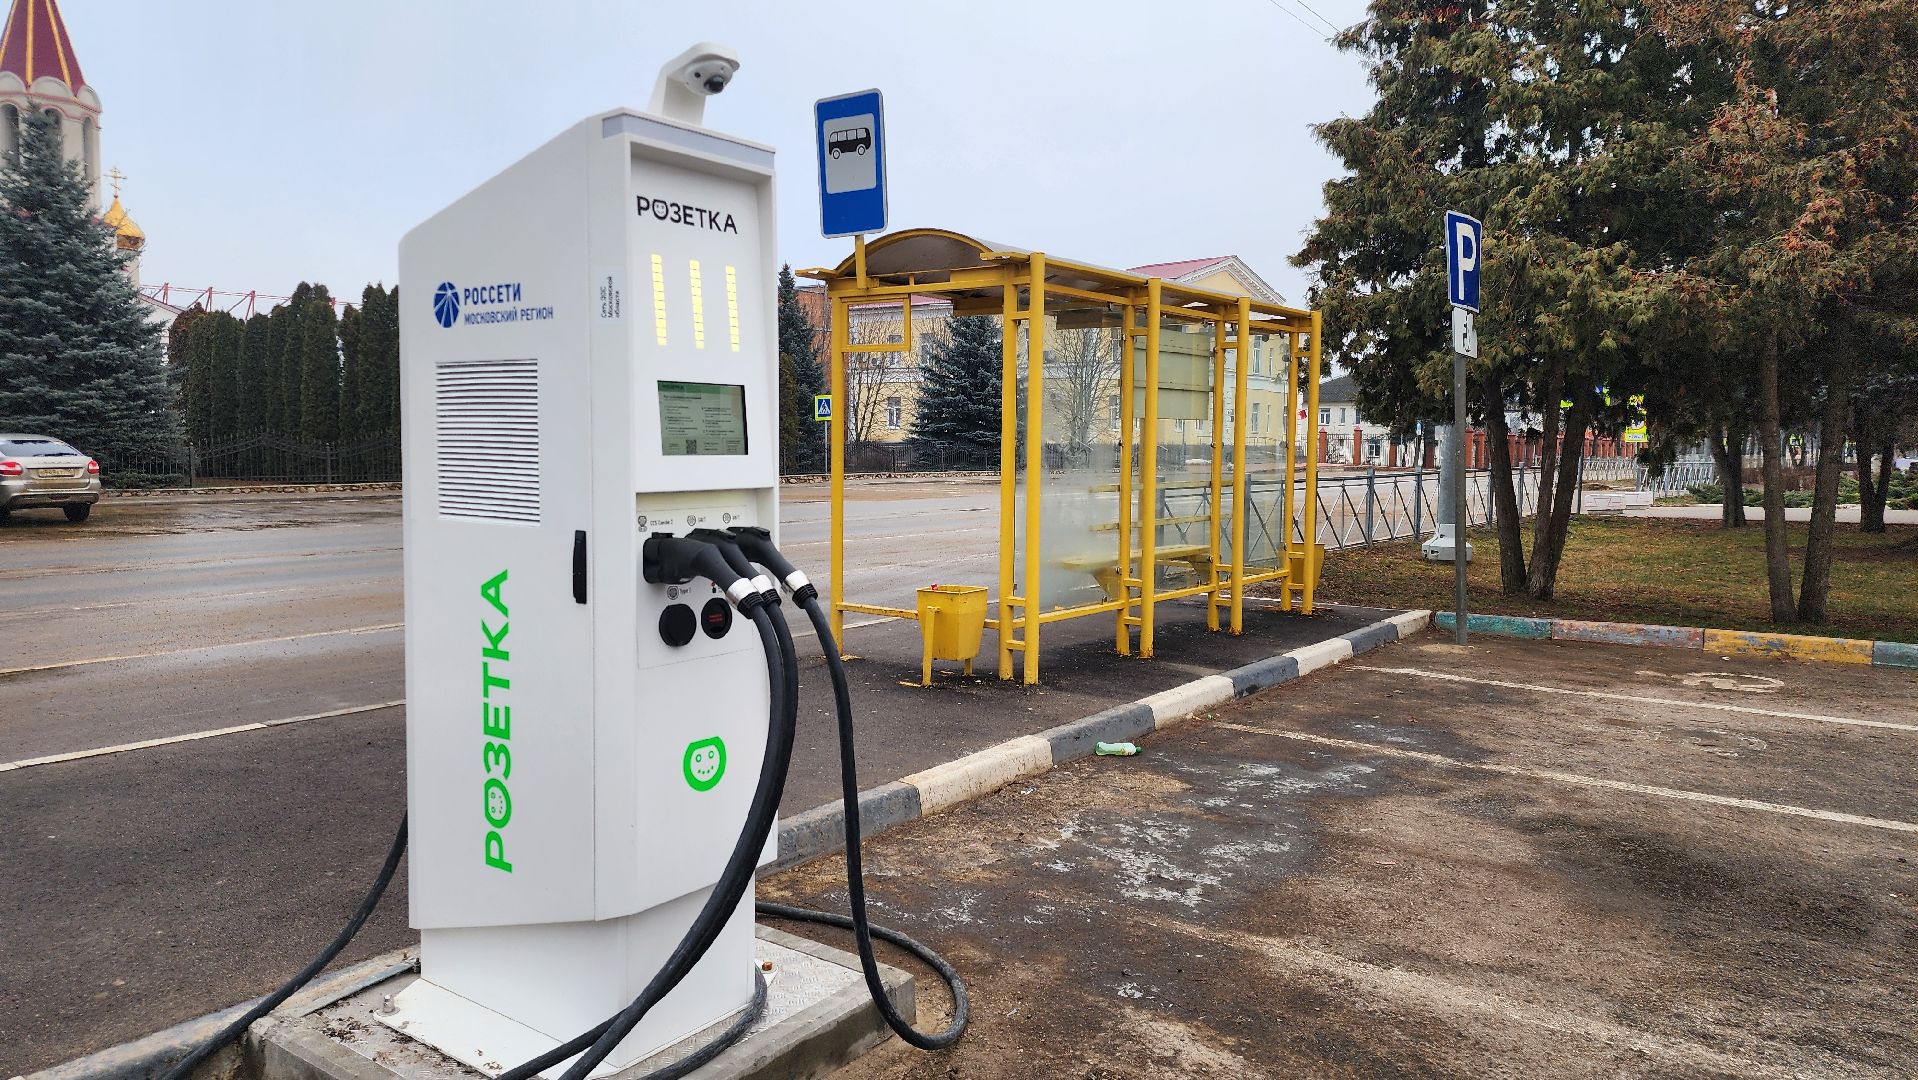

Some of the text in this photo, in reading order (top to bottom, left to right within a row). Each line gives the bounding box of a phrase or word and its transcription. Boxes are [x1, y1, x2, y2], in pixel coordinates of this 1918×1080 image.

[636, 194, 738, 235] РОЗЕТКА
[1456, 221, 1477, 301] P
[464, 282, 522, 306] РОССЕТИ
[464, 306, 554, 325] МОСКОВСКИЙ РЕГИОН
[481, 568, 513, 874] РОЗЕТКА
